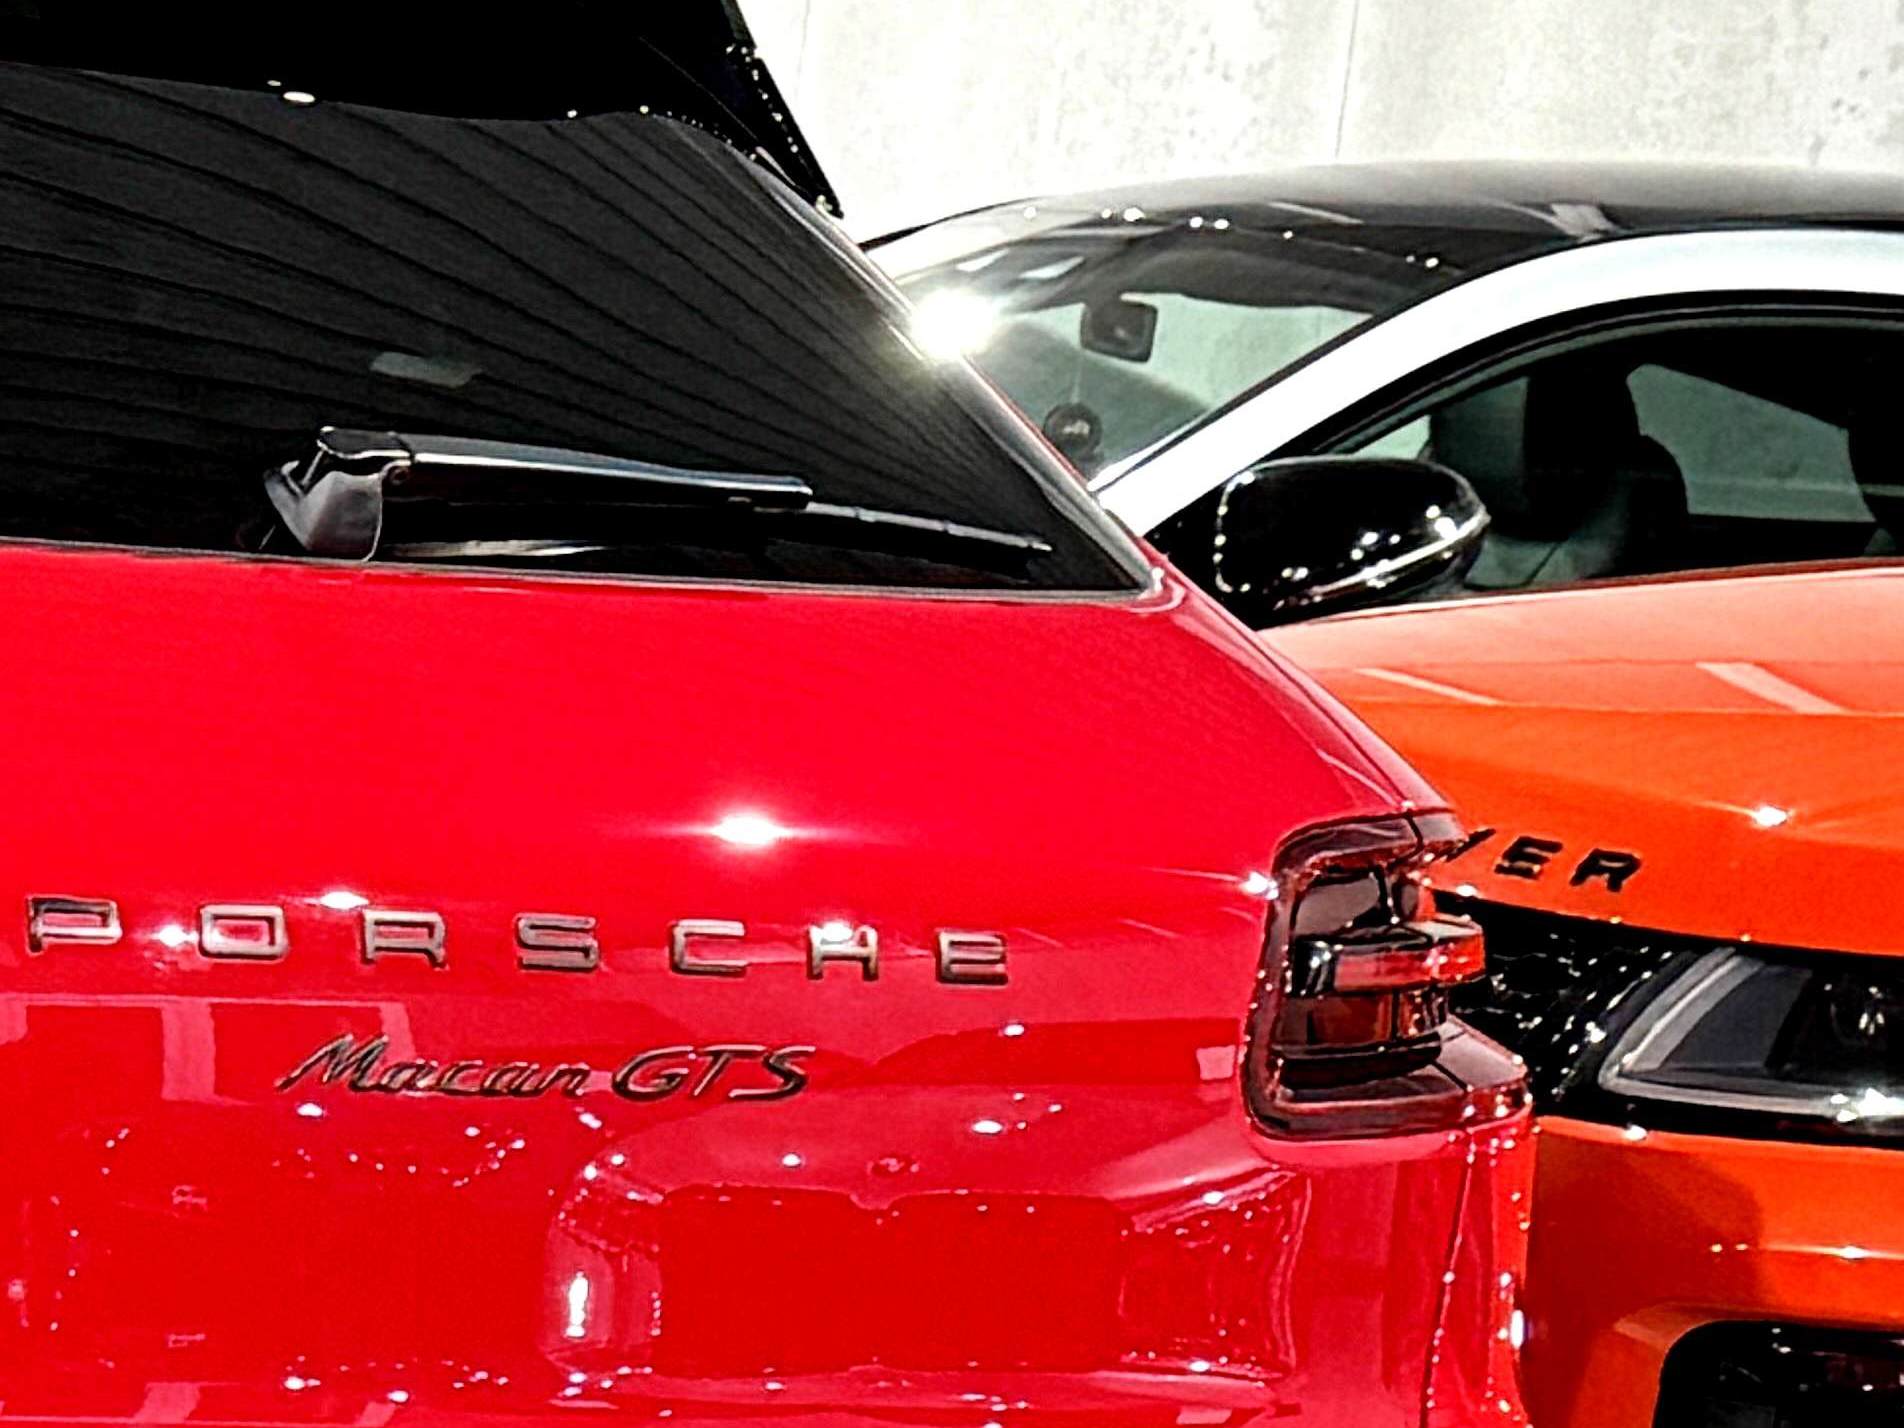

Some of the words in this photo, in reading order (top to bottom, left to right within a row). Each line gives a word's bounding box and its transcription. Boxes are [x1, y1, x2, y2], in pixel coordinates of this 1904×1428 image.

[27, 894, 1009, 985] PORSCHE
[274, 1034, 592, 1099] Macan
[610, 1045, 817, 1101] GTS
